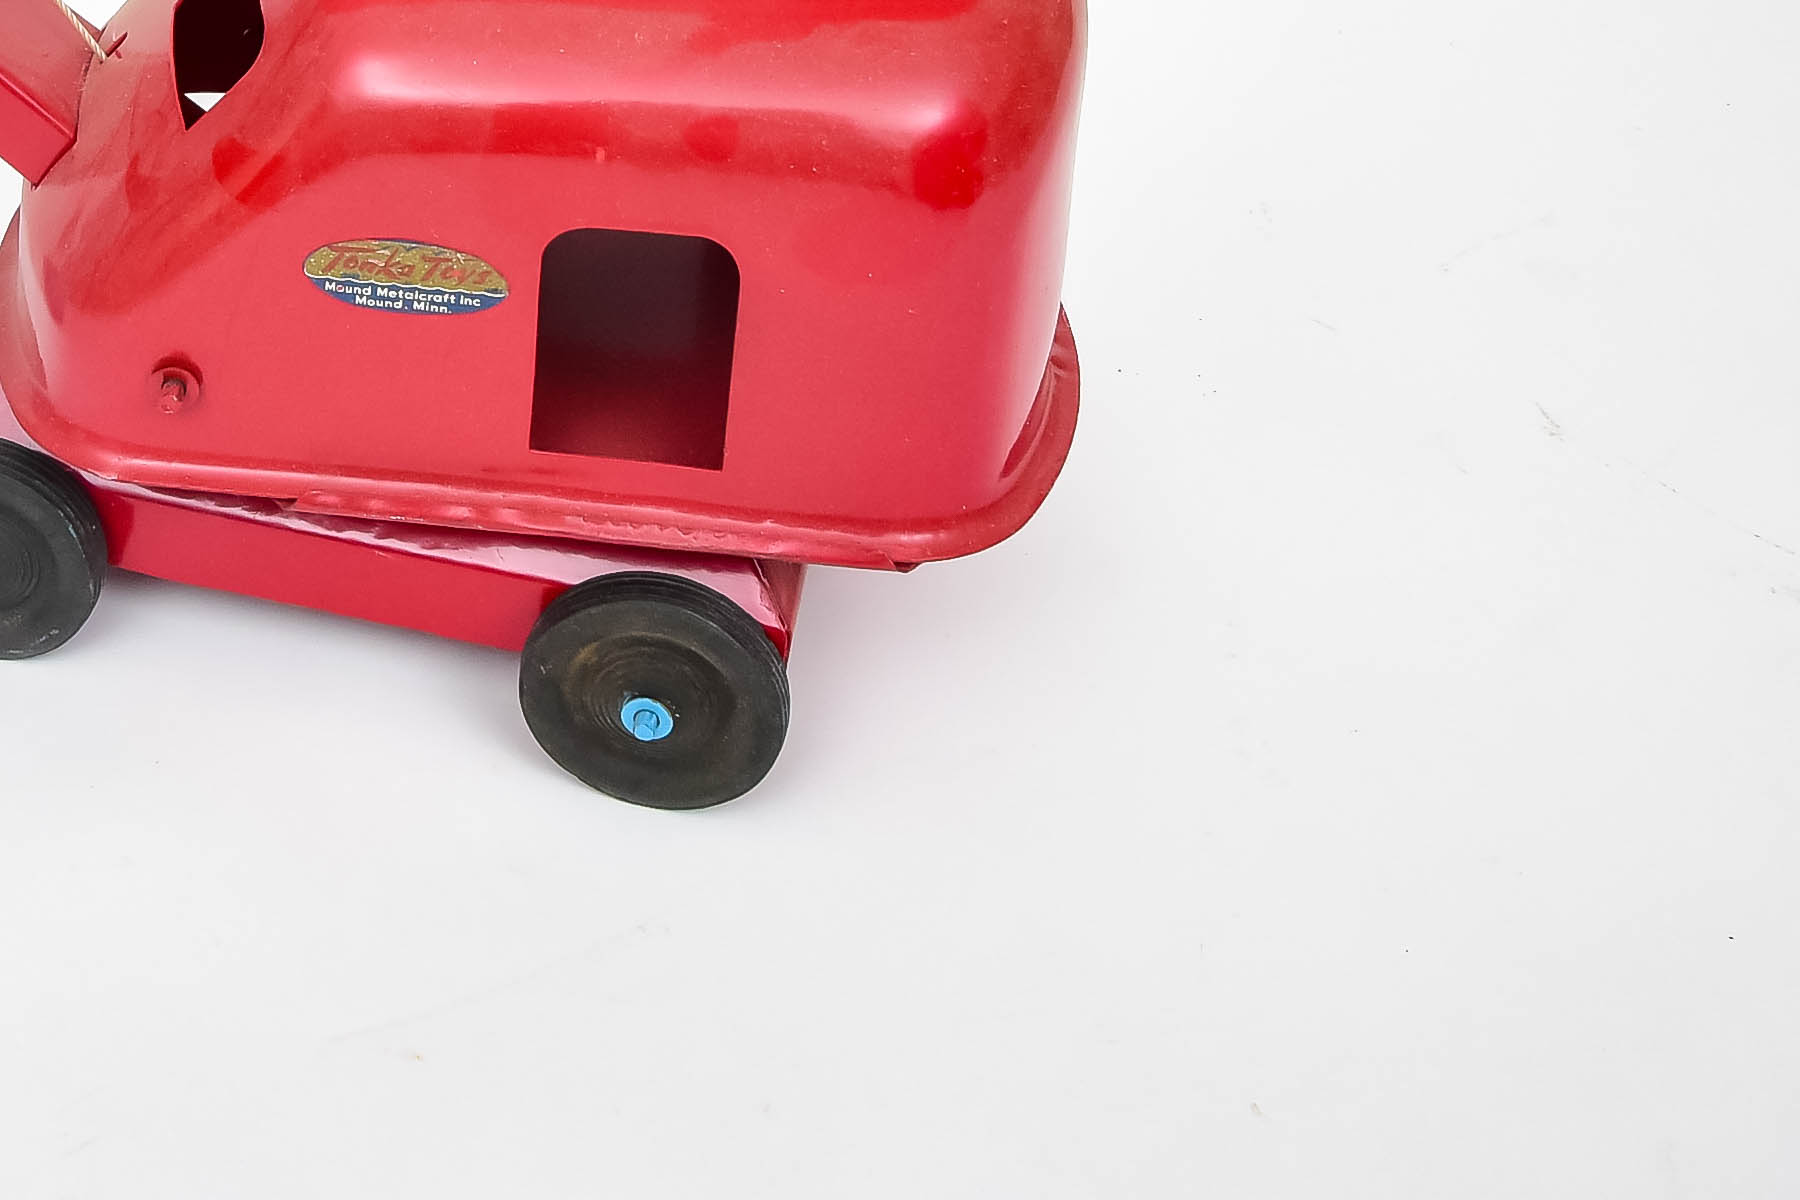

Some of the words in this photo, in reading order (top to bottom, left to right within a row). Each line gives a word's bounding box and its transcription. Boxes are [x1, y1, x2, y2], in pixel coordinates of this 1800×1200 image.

[322, 245, 415, 280] Tonka
[421, 255, 493, 286] Toys
[324, 280, 372, 296] Mound
[376, 286, 456, 305] Metalcraft
[412, 301, 452, 315] Minn.
